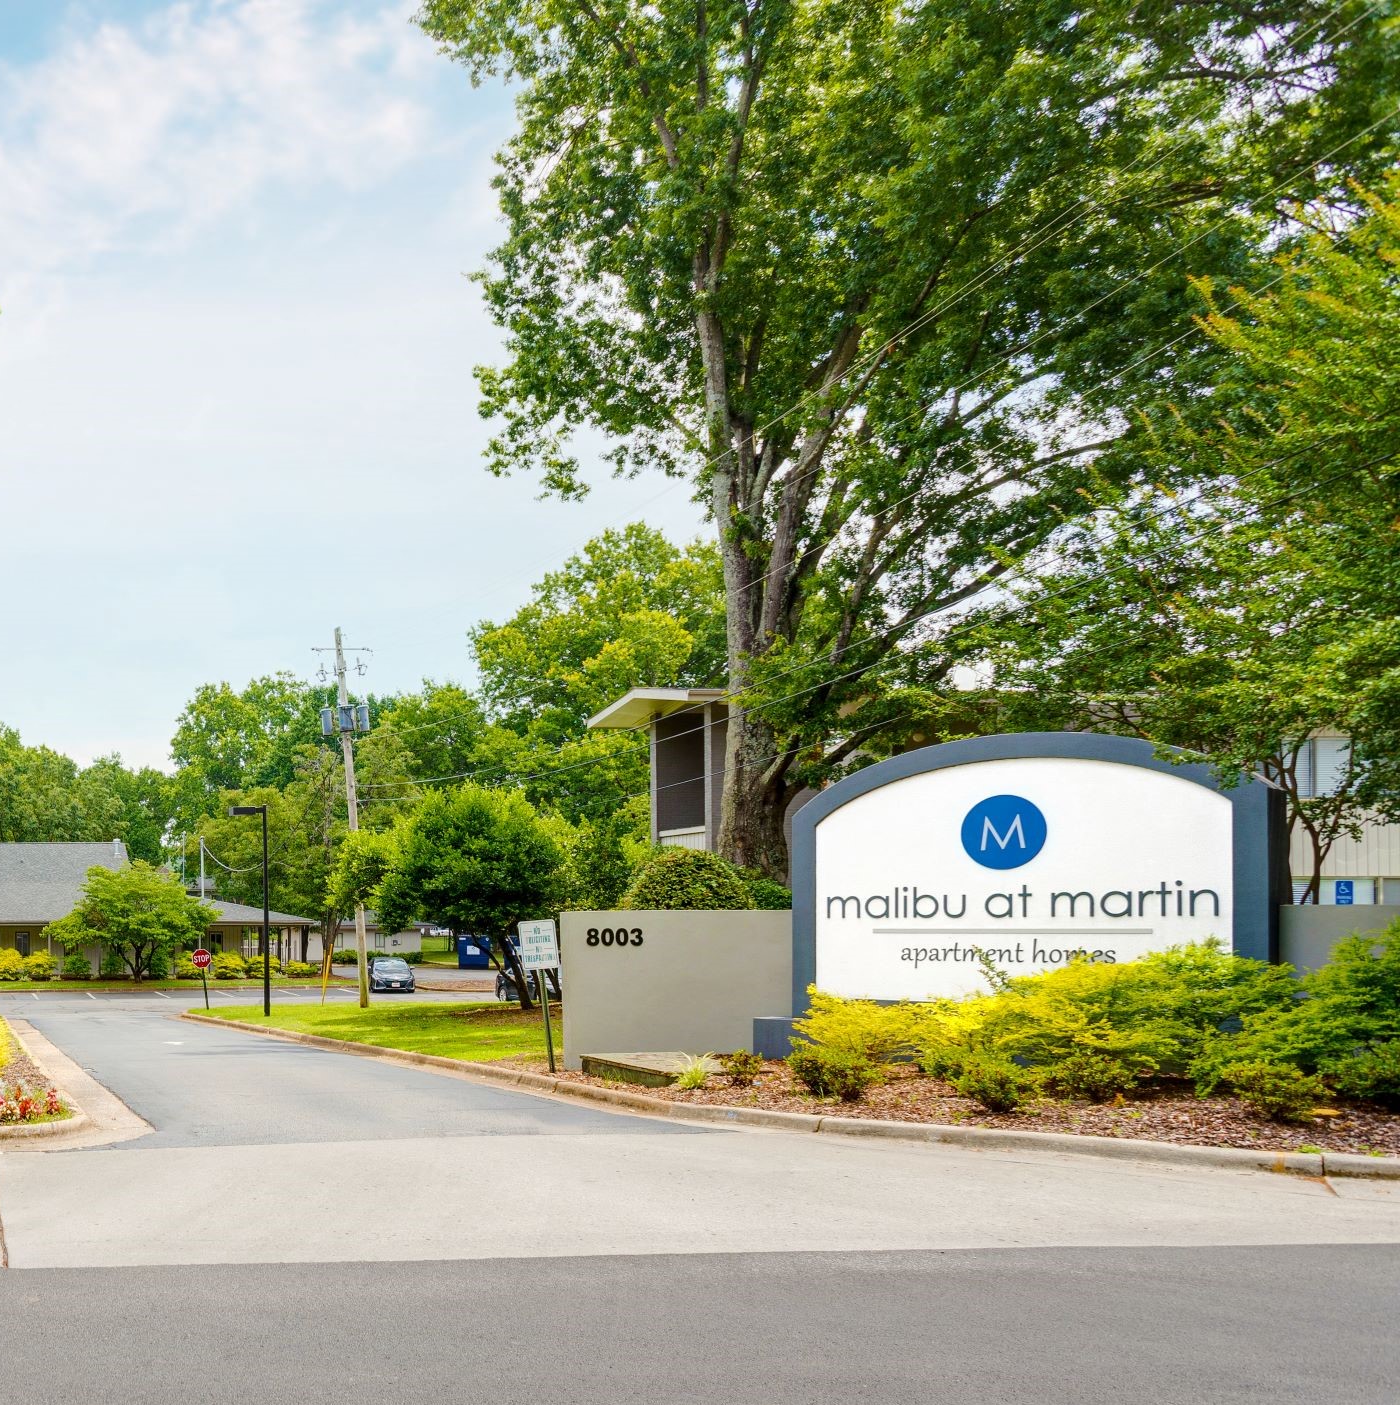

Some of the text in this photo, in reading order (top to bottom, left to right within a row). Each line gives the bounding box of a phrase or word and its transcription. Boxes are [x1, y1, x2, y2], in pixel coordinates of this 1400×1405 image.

[980, 813, 1026, 851] M
[826, 880, 1220, 919] malibu at martin
[586, 927, 644, 947] 8003
[194, 955, 210, 963] STOP
[900, 942, 1025, 969] apartment
